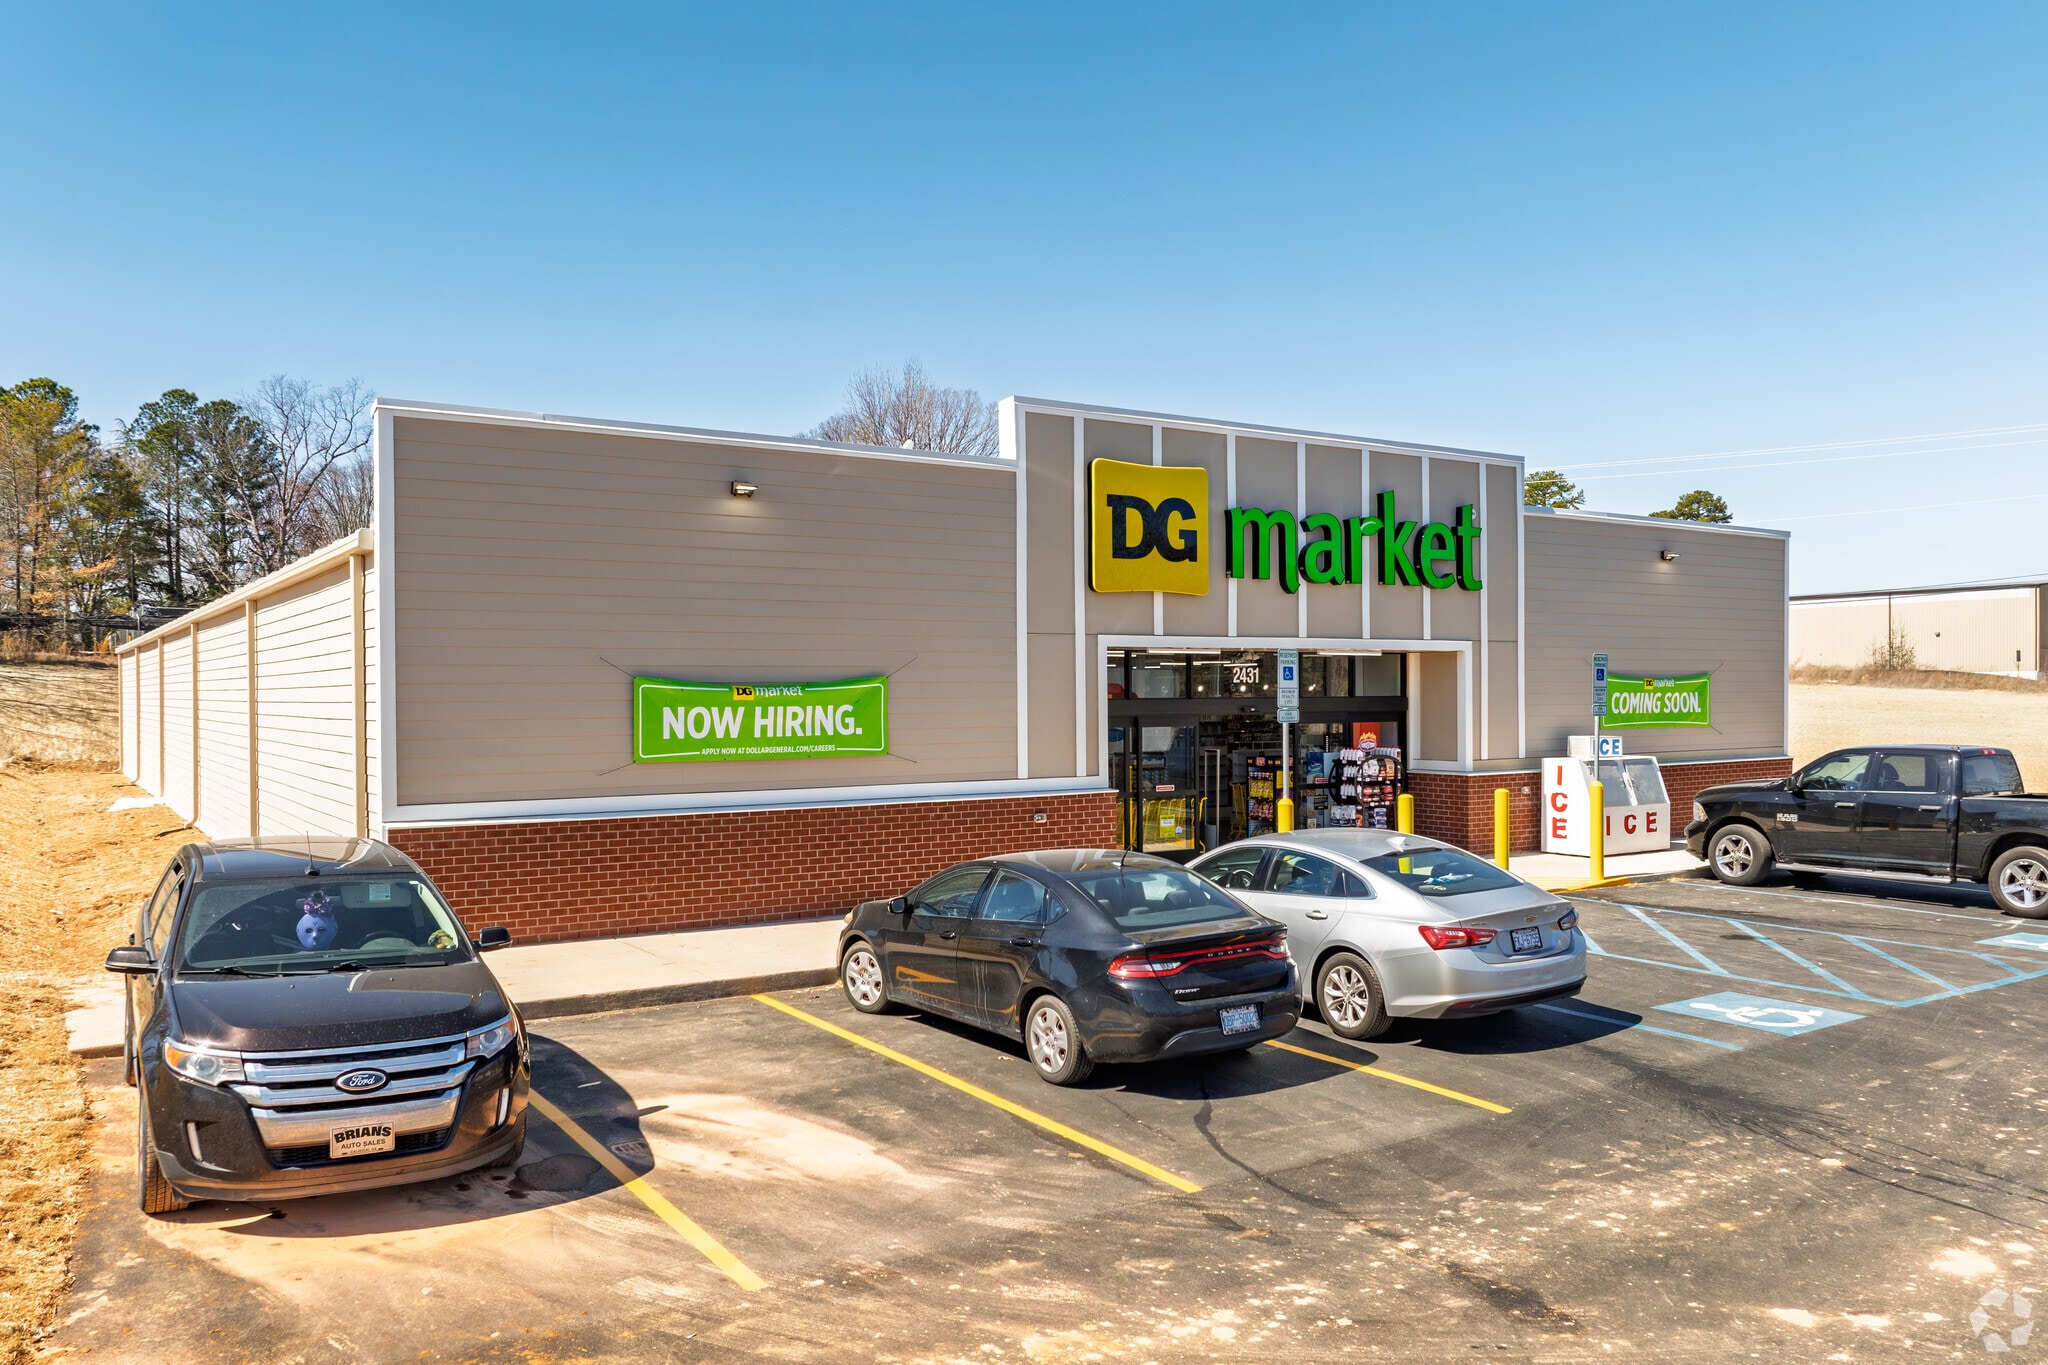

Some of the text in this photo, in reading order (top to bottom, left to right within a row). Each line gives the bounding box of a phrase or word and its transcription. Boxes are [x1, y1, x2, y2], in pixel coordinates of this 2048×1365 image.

[1106, 490, 1482, 594] DG market
[1232, 667, 1259, 683] 2431
[1645, 679, 1675, 687] DG market
[735, 685, 803, 698] DG market
[1611, 692, 1662, 714] COMING
[1663, 691, 1702, 713] SOON.
[662, 704, 863, 740] NOW HIRING.
[721, 747, 736, 755] NOW
[746, 745, 836, 754] DOLLARGENERAL.COM/CAREERS
[1551, 766, 1568, 839] ICE
[1606, 811, 1657, 836] ICE
[350, 1074, 375, 1086] Ford
[334, 1126, 391, 1143] BRIANS
[341, 1138, 386, 1149] AUTO SALES
